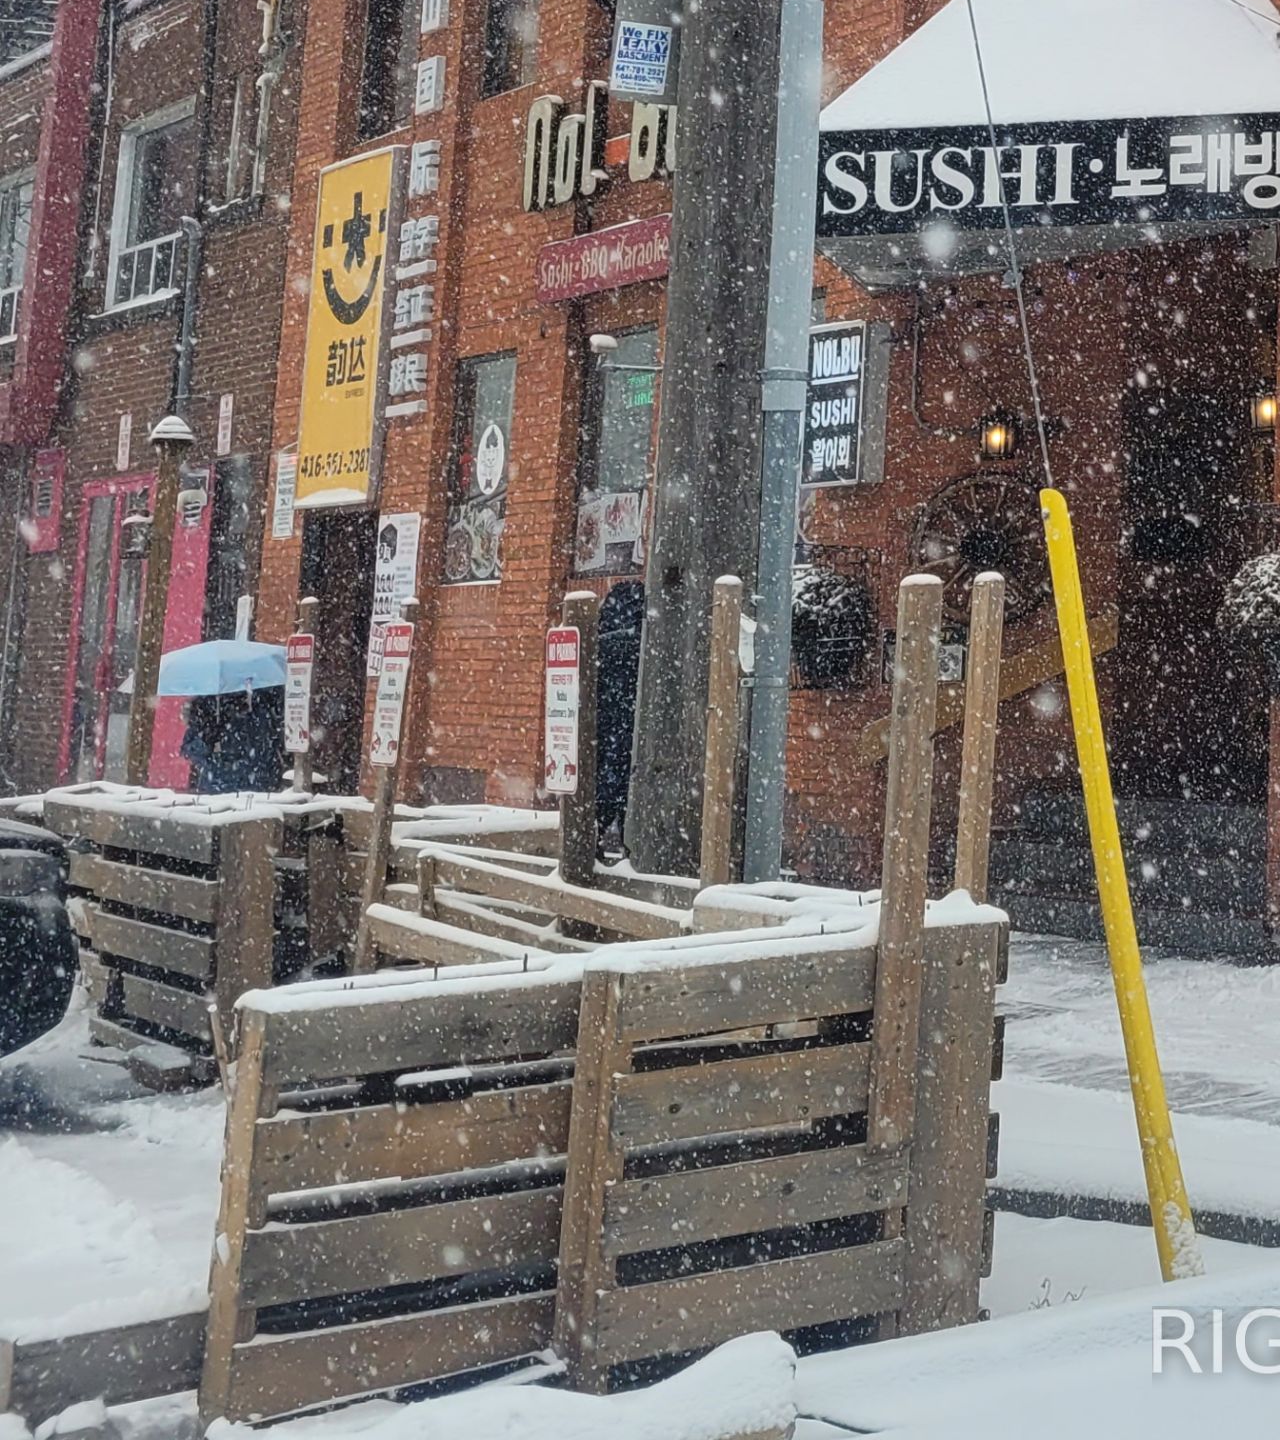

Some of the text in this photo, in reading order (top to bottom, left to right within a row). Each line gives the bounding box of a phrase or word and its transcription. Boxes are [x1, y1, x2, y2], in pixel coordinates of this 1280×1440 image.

[620, 37, 668, 54] LEAKY
[622, 26, 668, 41] We FIX
[823, 142, 1083, 215] SUSHI
[326, 334, 367, 388] 韵达
[812, 335, 861, 378] NOLBU
[811, 397, 856, 428] SUSHI
